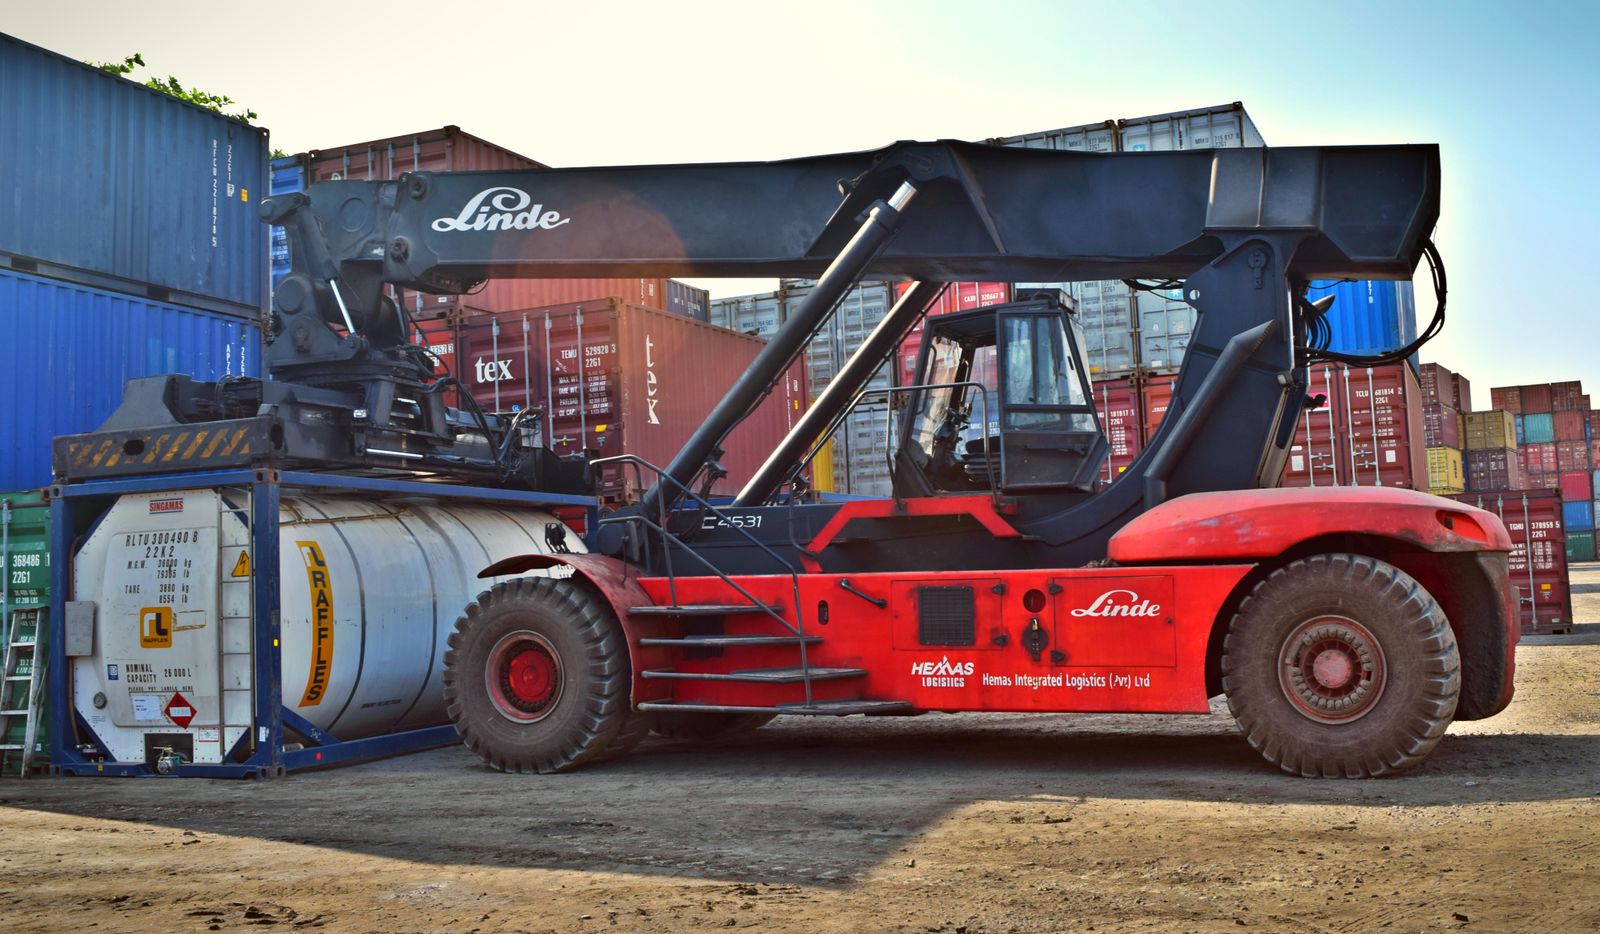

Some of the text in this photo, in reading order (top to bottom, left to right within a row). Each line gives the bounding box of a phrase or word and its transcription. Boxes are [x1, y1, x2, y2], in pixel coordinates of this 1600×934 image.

[431, 186, 570, 232] Linde
[561, 344, 616, 359] TEMU 529920 3
[585, 357, 601, 368] 22G1
[475, 357, 514, 384] tex
[645, 335, 660, 425] tex
[149, 500, 184, 512] SINGAMAS
[126, 534, 149, 547] RLTU
[151, 531, 189, 545] 300490
[1531, 530, 1546, 538] 22G1
[12, 554, 40, 567] 368486
[12, 571, 31, 584] 22G1
[125, 584, 140, 594] TARE
[1071, 589, 1161, 617] Linde
[306, 570, 330, 701] RAFFLES
[126, 664, 152, 673] NOMINAL
[911, 655, 974, 676] HEMAS
[127, 674, 157, 683] CAPACITY
[922, 677, 965, 688] LOGISTICS
[983, 673, 1012, 686] Hemas
[1015, 673, 1063, 690] Integrated
[1066, 673, 1106, 690] Logistics
